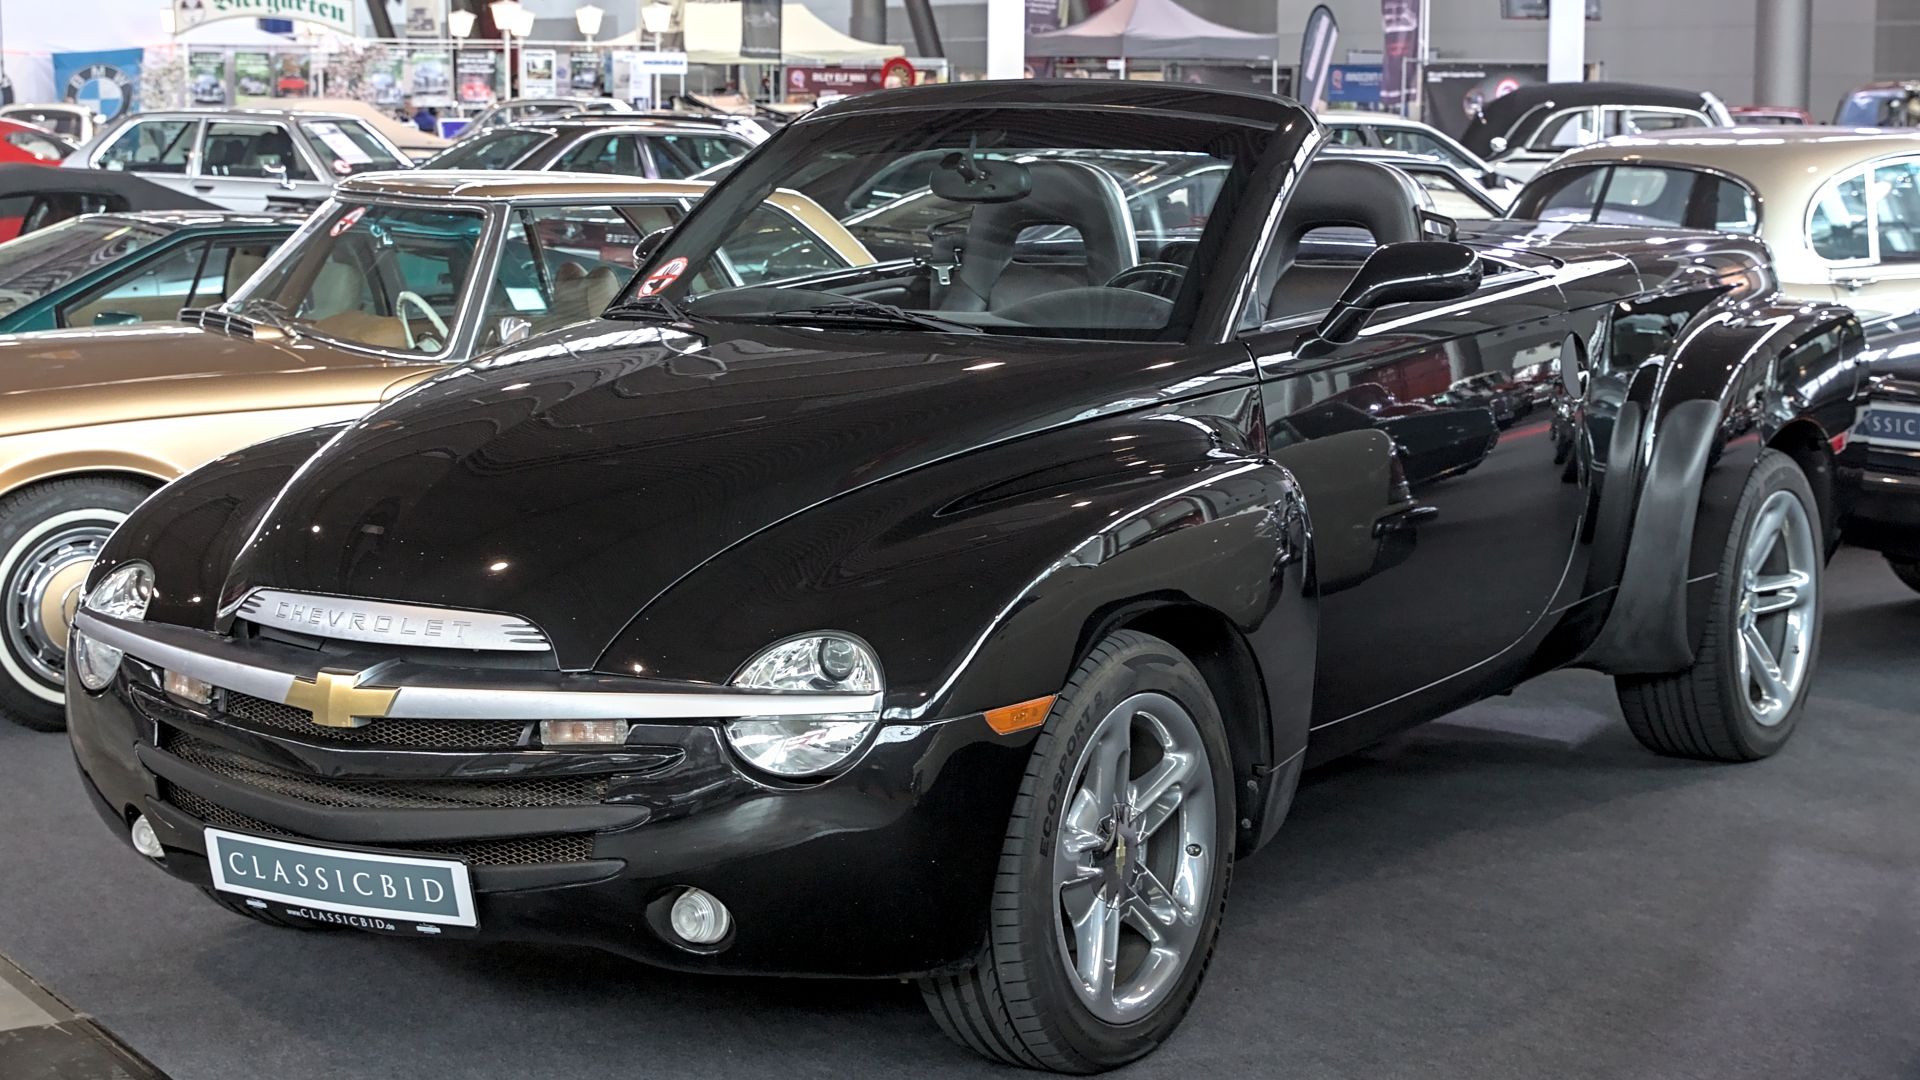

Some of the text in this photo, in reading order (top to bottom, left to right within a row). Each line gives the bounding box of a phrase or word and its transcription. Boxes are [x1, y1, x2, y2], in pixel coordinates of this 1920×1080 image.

[275, 601, 472, 638] CHEVROLET
[1040, 705, 1090, 858] ECOSPORT
[228, 851, 444, 903] CLASSICBID
